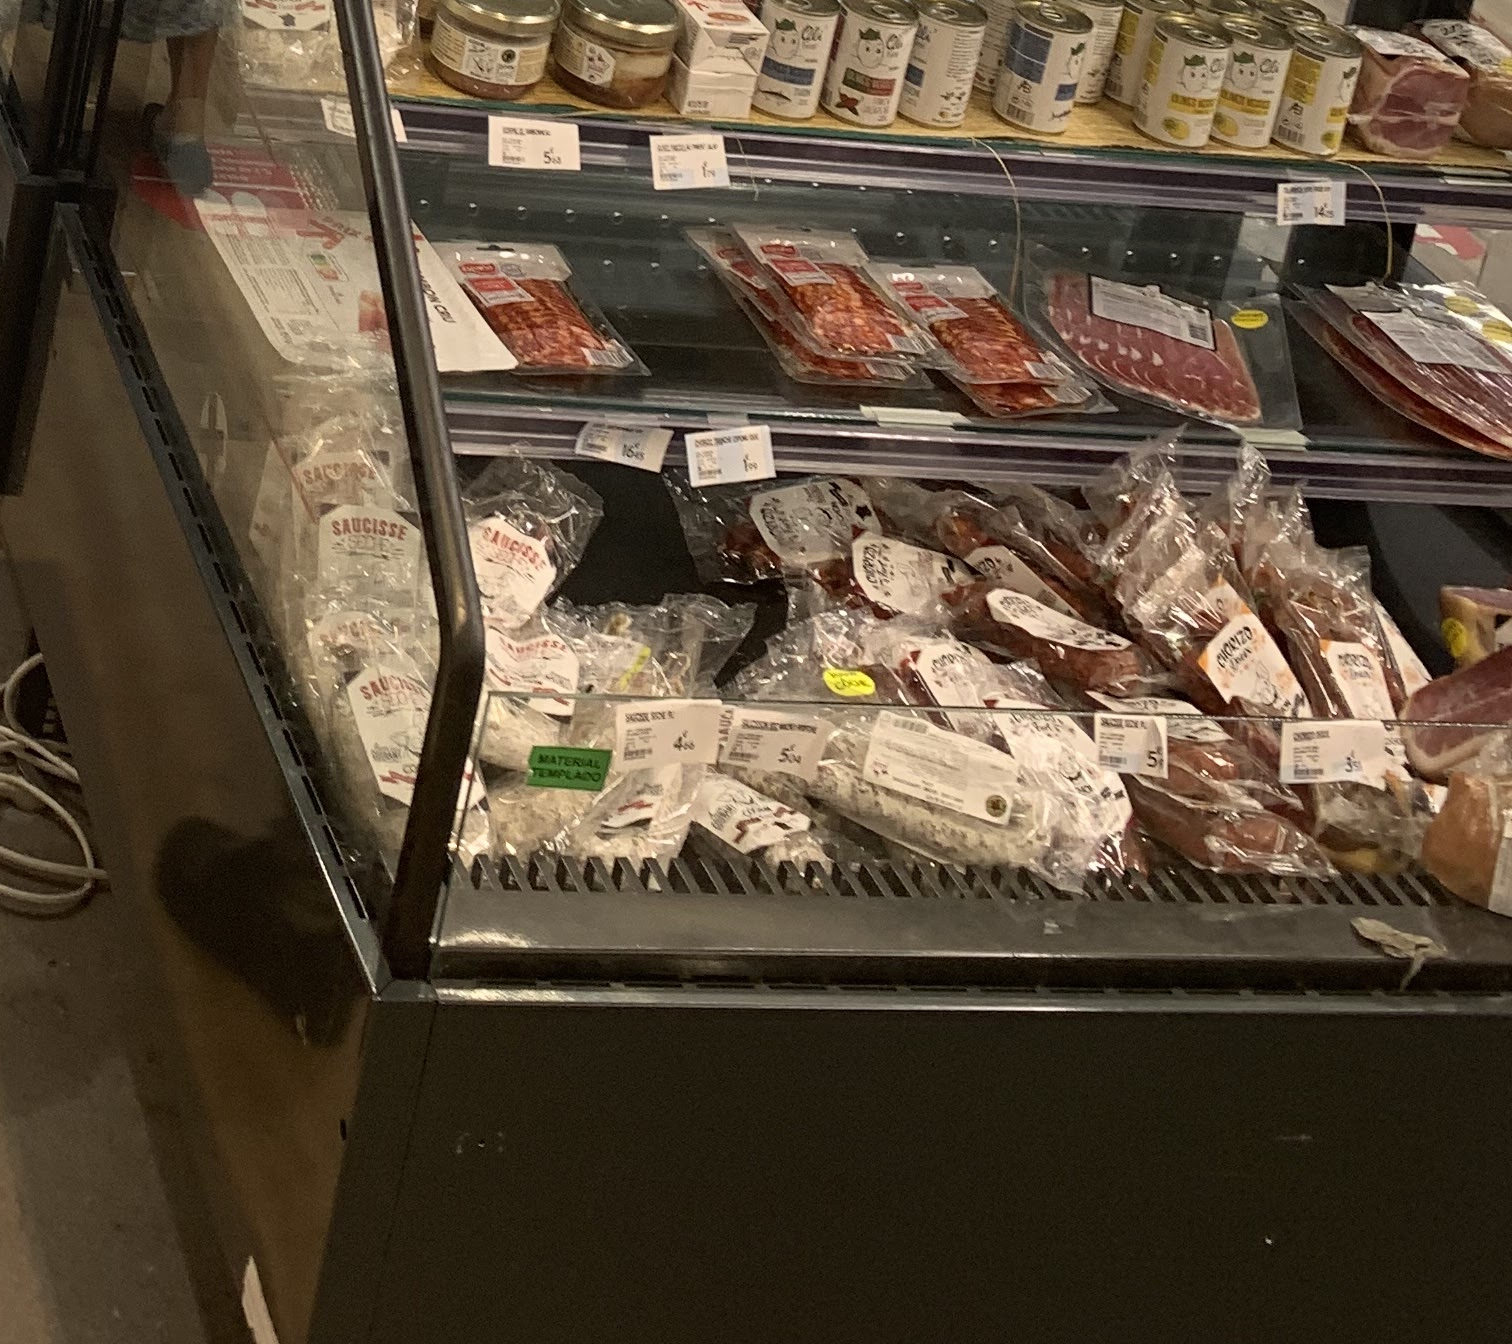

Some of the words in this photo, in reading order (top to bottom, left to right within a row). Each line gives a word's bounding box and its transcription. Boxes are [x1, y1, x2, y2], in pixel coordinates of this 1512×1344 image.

[332, 516, 407, 541] SAUCISSE
[482, 525, 548, 570] SAUCISSE
[1216, 625, 1255, 670] CHORIZO
[536, 754, 601, 769] MATERIAL
[531, 767, 602, 783] TEMPLADO
